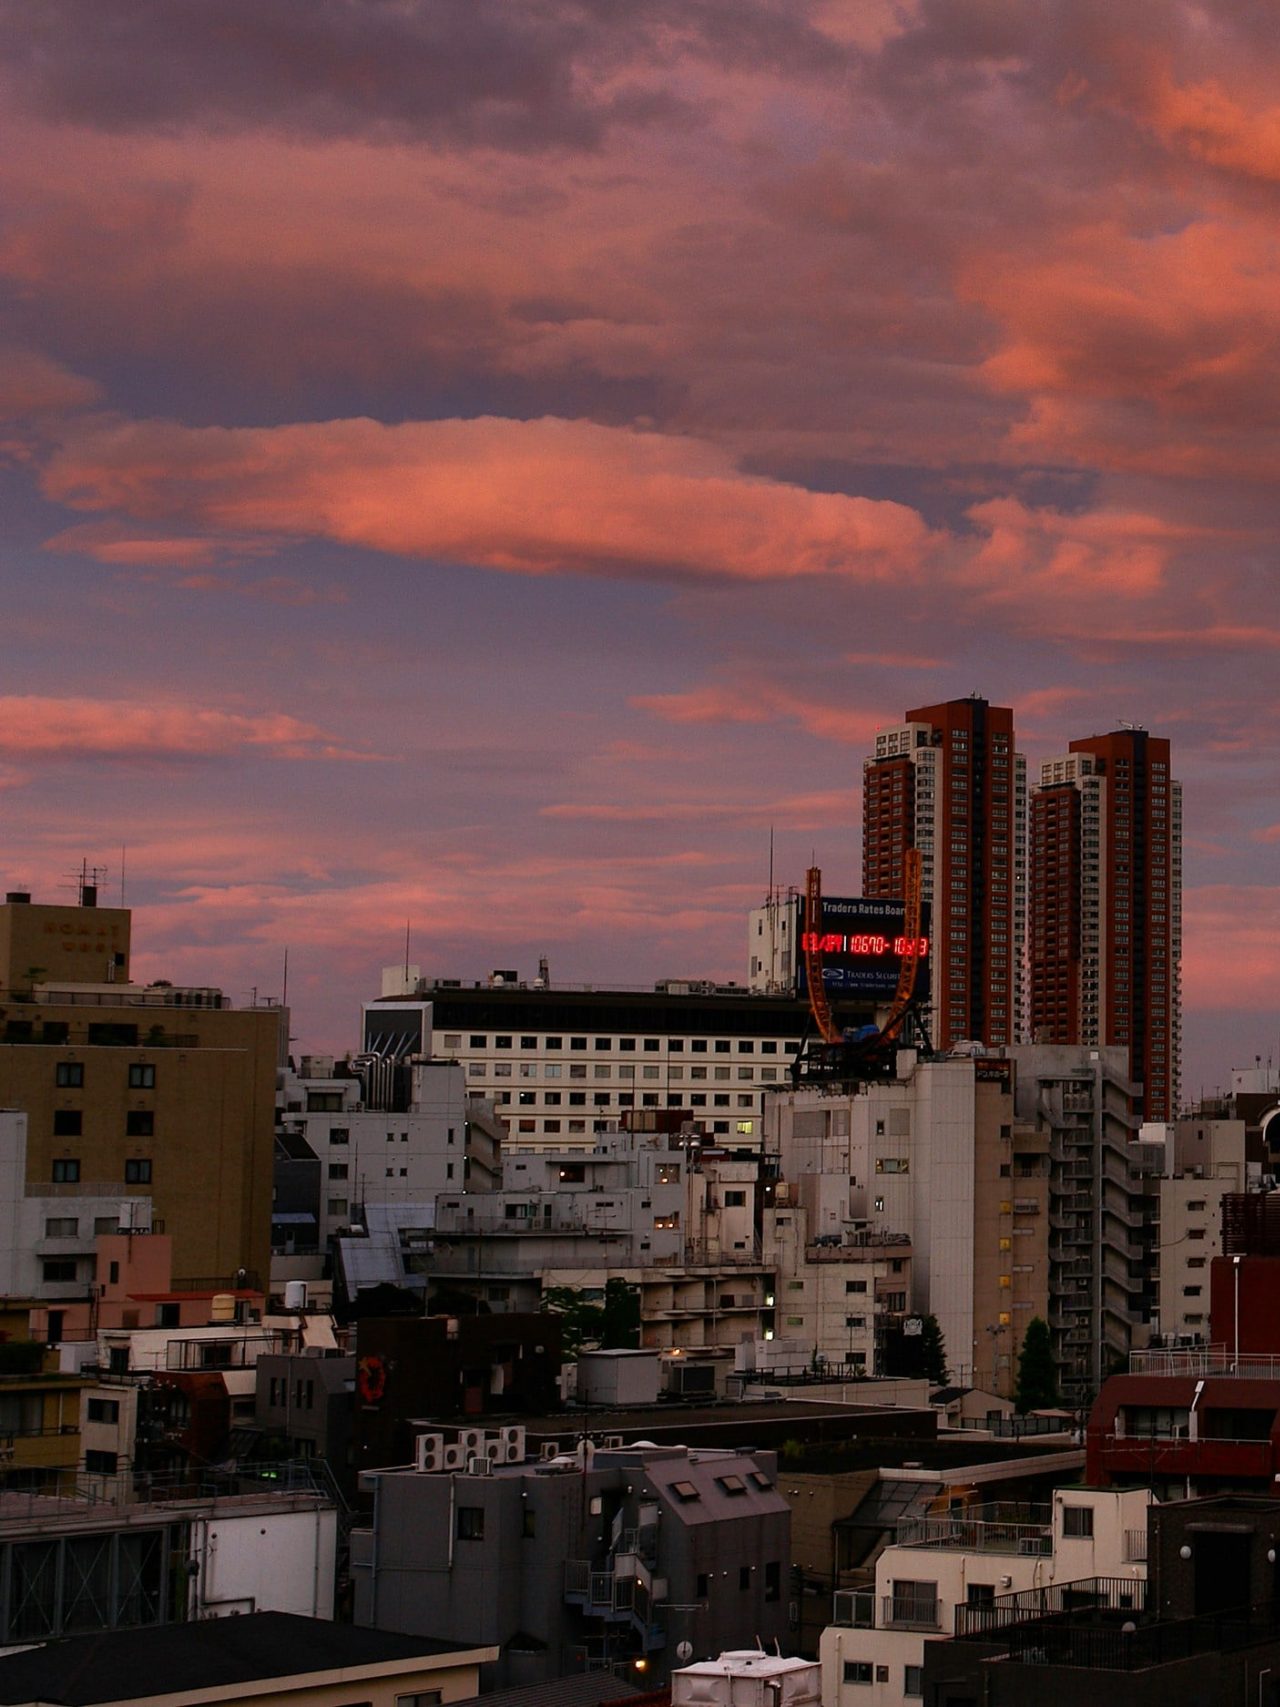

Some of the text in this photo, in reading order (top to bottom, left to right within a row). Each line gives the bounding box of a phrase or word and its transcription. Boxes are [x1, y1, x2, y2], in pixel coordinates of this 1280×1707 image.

[823, 902, 906, 916] Traders Rates Boar
